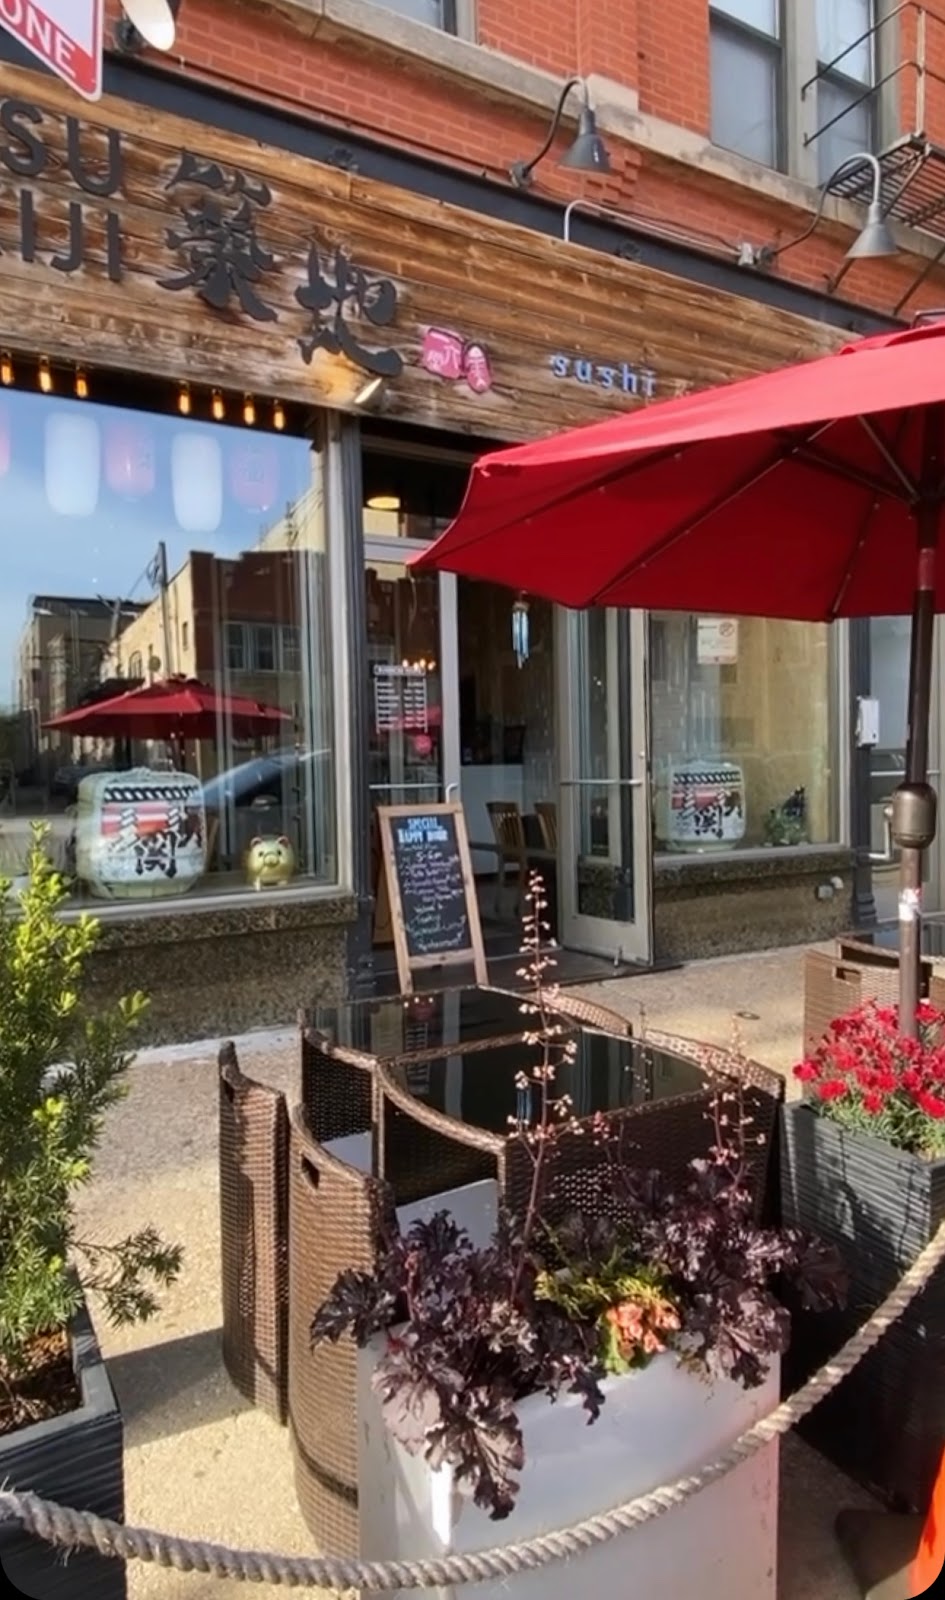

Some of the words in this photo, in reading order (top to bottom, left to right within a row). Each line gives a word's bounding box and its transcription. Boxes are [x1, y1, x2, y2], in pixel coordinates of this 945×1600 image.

[1, 100, 121, 196] SU
[0, 189, 121, 283] IJI
[551, 354, 656, 397] sushi
